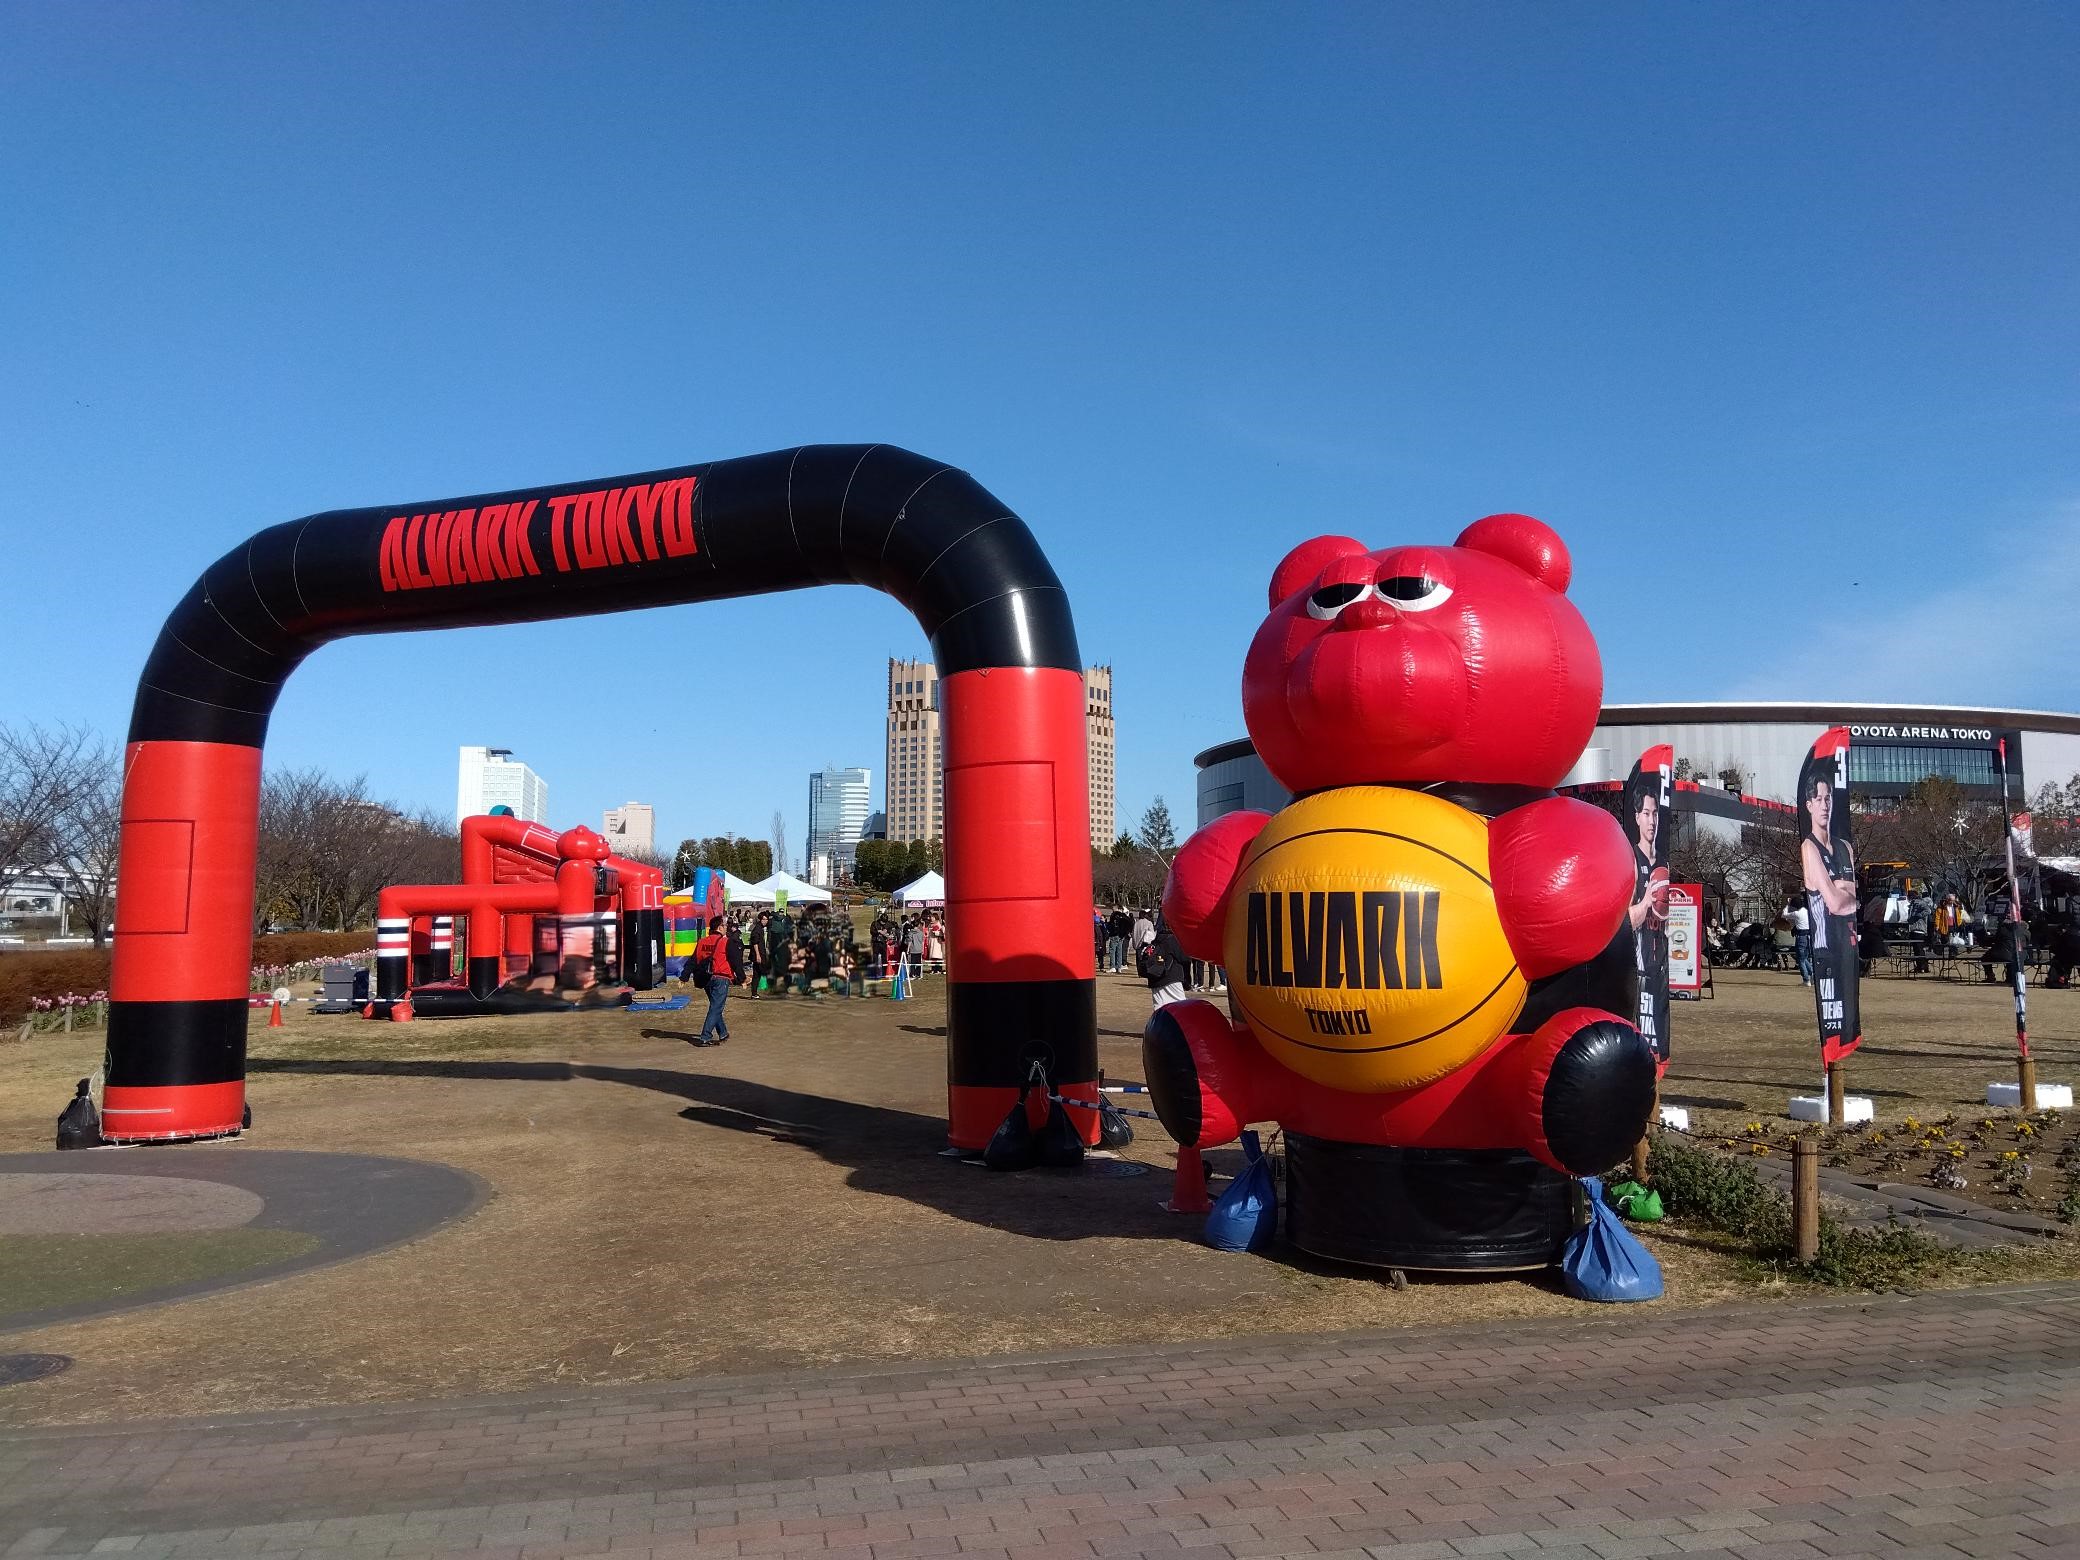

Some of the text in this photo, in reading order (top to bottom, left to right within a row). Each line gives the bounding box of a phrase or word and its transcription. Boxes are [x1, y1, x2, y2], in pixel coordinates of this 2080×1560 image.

[379, 476, 697, 592] ALVARK TOKYO
[1901, 726, 1949, 738] ARENA
[1950, 728, 1992, 740] TOKYO
[1659, 763, 1671, 807] 2
[1834, 746, 1847, 789] 3
[1246, 891, 1442, 990] ALVARK
[1304, 1007, 1372, 1036] TOKYO
